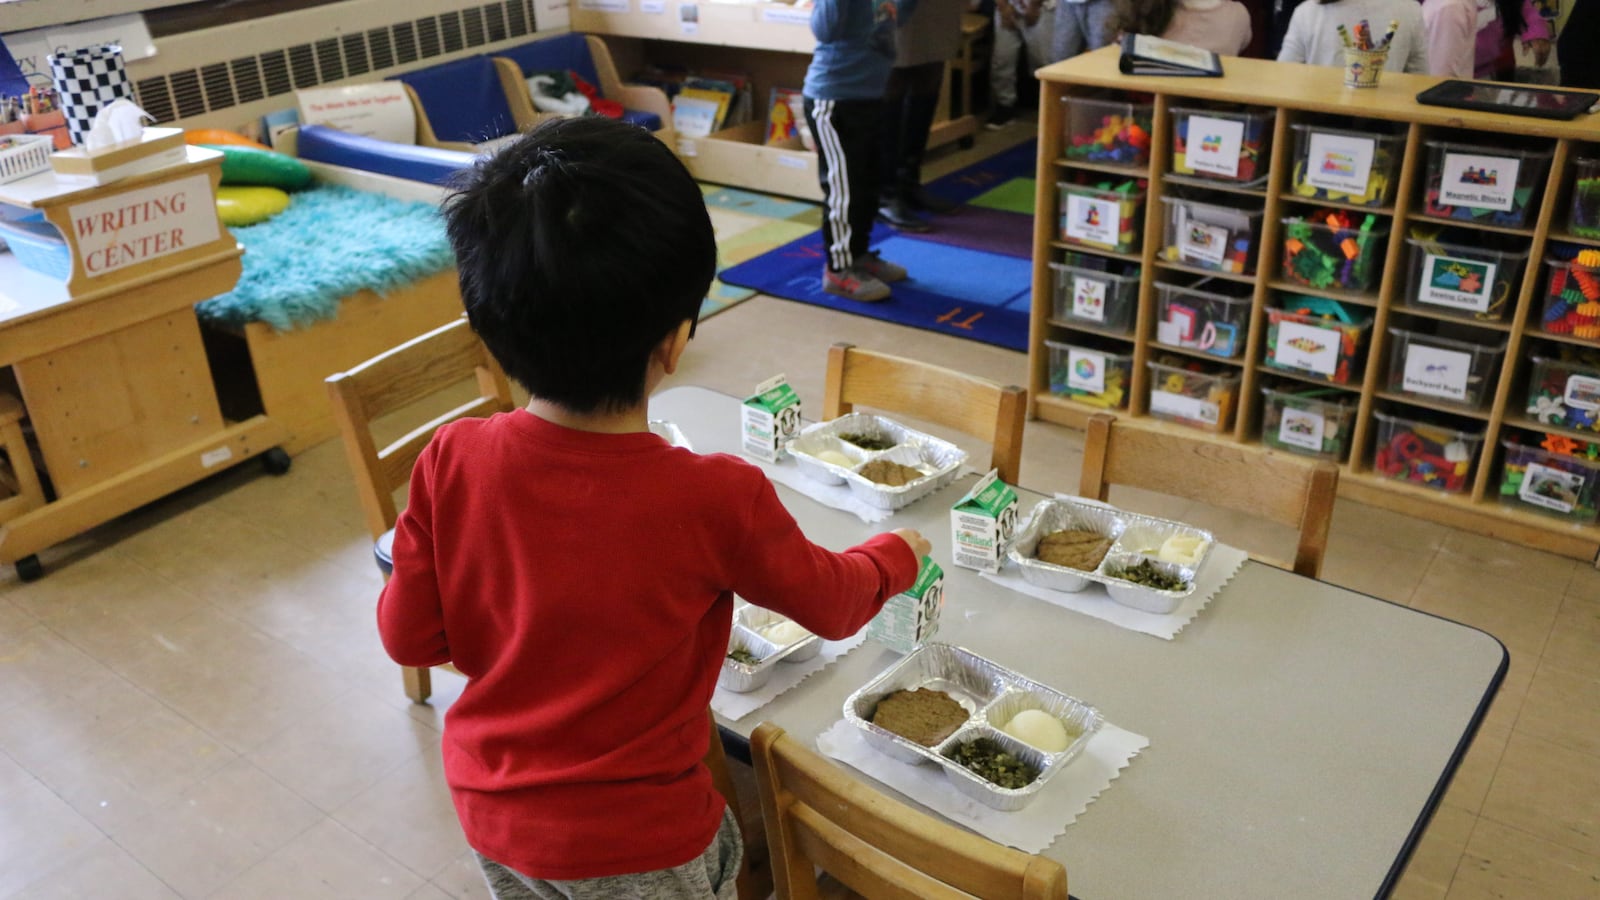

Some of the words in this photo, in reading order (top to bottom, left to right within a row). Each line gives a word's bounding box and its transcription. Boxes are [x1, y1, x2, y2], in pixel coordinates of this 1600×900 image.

[1446, 191, 1478, 202] Magnetic
[1480, 194, 1507, 205] Blocks
[76, 192, 187, 240] WRITING
[86, 228, 185, 272] CENTER
[1406, 377, 1442, 389] Backyard
[1443, 384, 1463, 395] Bugs
